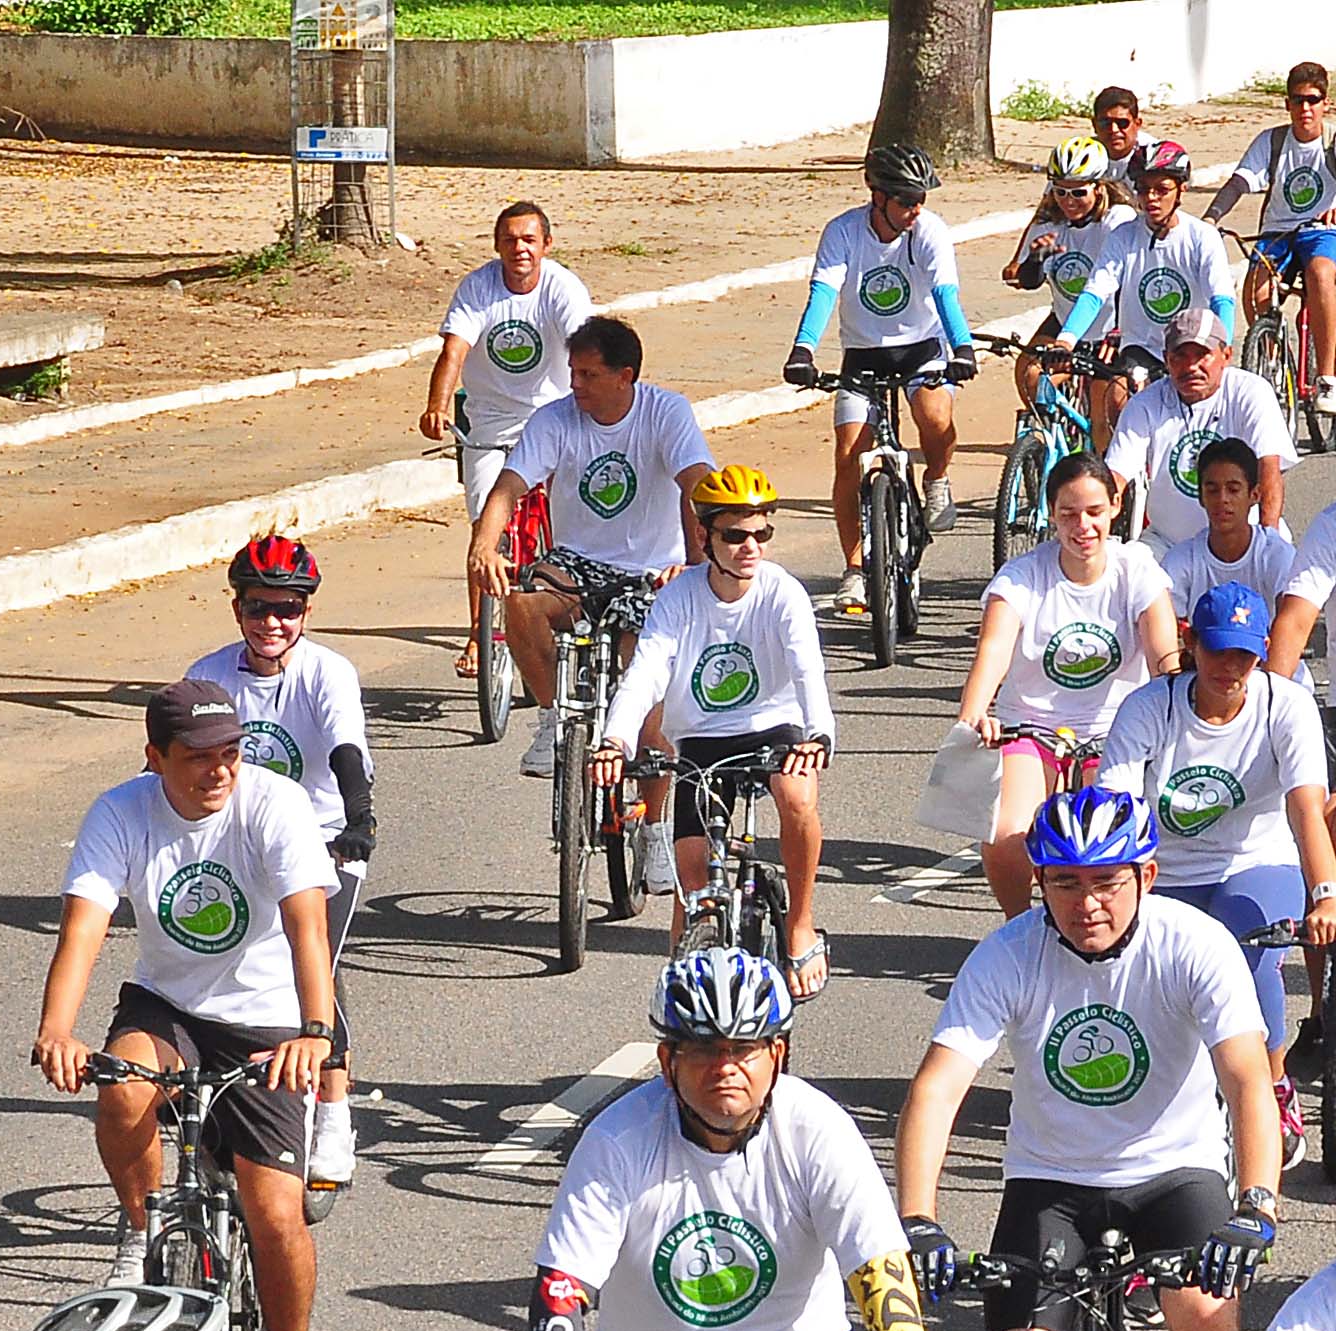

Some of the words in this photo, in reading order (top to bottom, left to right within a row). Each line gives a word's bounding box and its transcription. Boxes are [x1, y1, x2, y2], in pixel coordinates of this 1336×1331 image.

[1049, 1037, 1061, 1048] II
[1055, 1008, 1098, 1039] Passeio
[1102, 1009, 1142, 1050] Ciclistico
[659, 1246, 672, 1259] II
[718, 1212, 769, 1261] Ciclistico
